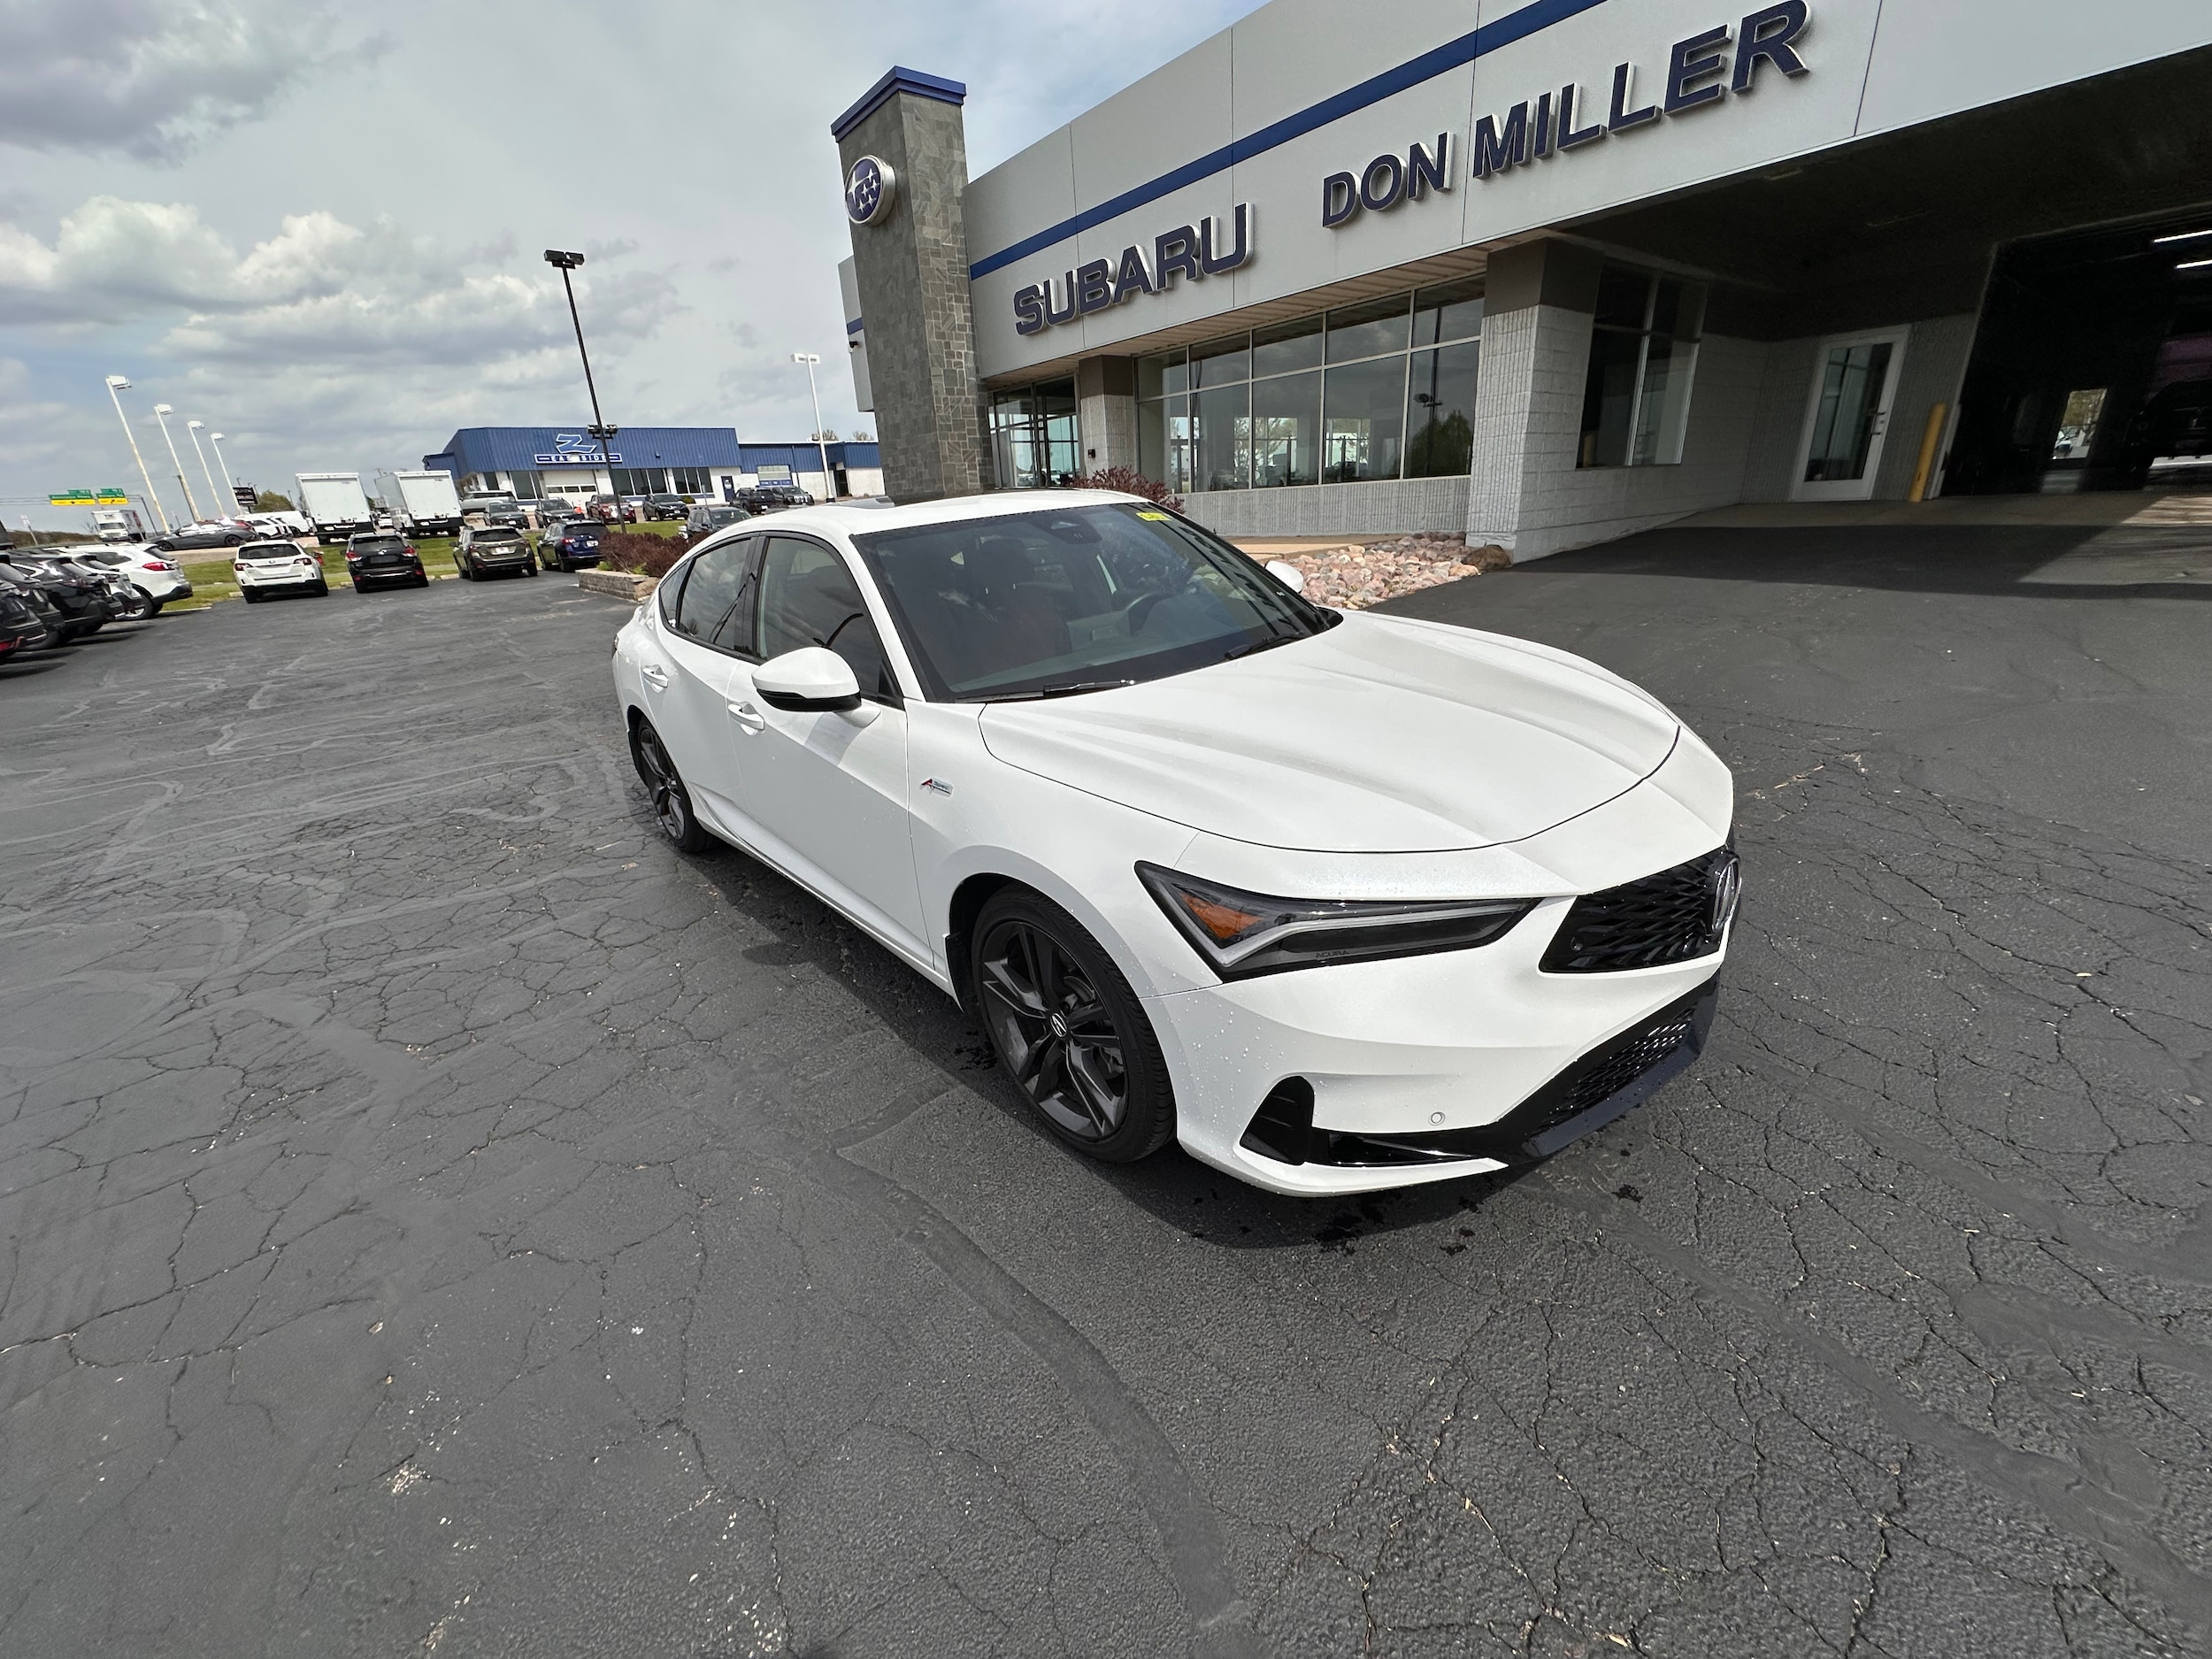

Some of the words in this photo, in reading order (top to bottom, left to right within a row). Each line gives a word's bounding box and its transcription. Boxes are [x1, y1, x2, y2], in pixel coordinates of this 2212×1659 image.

[1322, 131, 1454, 228] DON
[1472, 0, 1812, 180] MILLER
[1013, 202, 1254, 335] SUBARU
[1316, 949, 1350, 958] ACURA
